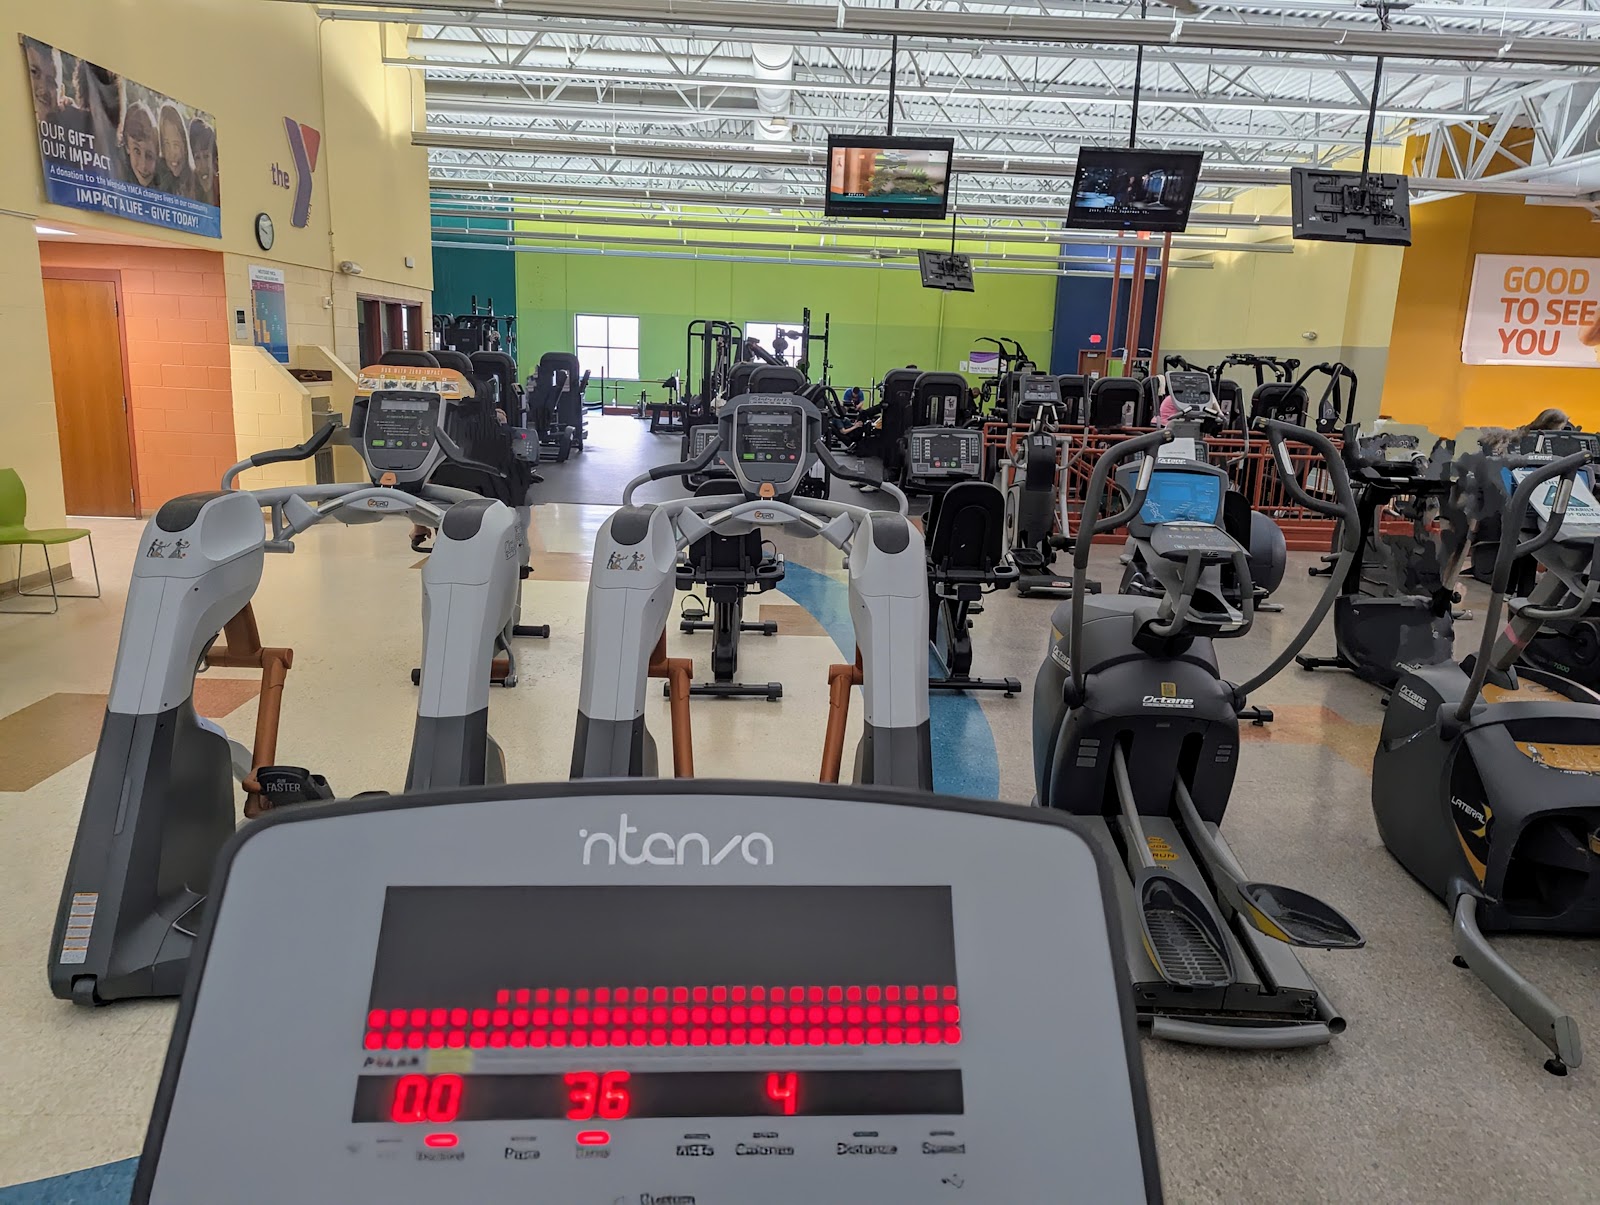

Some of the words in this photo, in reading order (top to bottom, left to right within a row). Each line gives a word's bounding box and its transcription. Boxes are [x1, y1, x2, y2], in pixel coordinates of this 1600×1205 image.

[68, 129, 95, 149] GIFT
[69, 146, 111, 171] IMPACT
[50, 164, 56, 174] A
[56, 167, 84, 181] donation
[85, 173, 95, 183] to
[96, 175, 107, 186] the
[126, 184, 143, 196] YMCA
[142, 189, 163, 202] changes
[271, 162, 290, 189] the
[76, 187, 118, 209] IMPACT
[119, 198, 126, 212] A
[126, 200, 144, 216] LIFE
[151, 206, 171, 222] GIVE
[171, 210, 199, 228] TODAY!
[1503, 266, 1590, 295] GOOD
[1500, 297, 1540, 325] TO
[1544, 299, 1598, 326] SEE
[1498, 328, 1561, 356] YOU
[1052, 644, 1071, 665] Octan
[1553, 662, 1571, 673] 7000
[1142, 695, 1194, 705] Octane
[1400, 684, 1428, 706] Octane
[266, 782, 300, 792] FASTER
[1451, 795, 1486, 825] LATERAL
[564, 1070, 631, 1121] 36
[765, 1071, 799, 1116] 4
